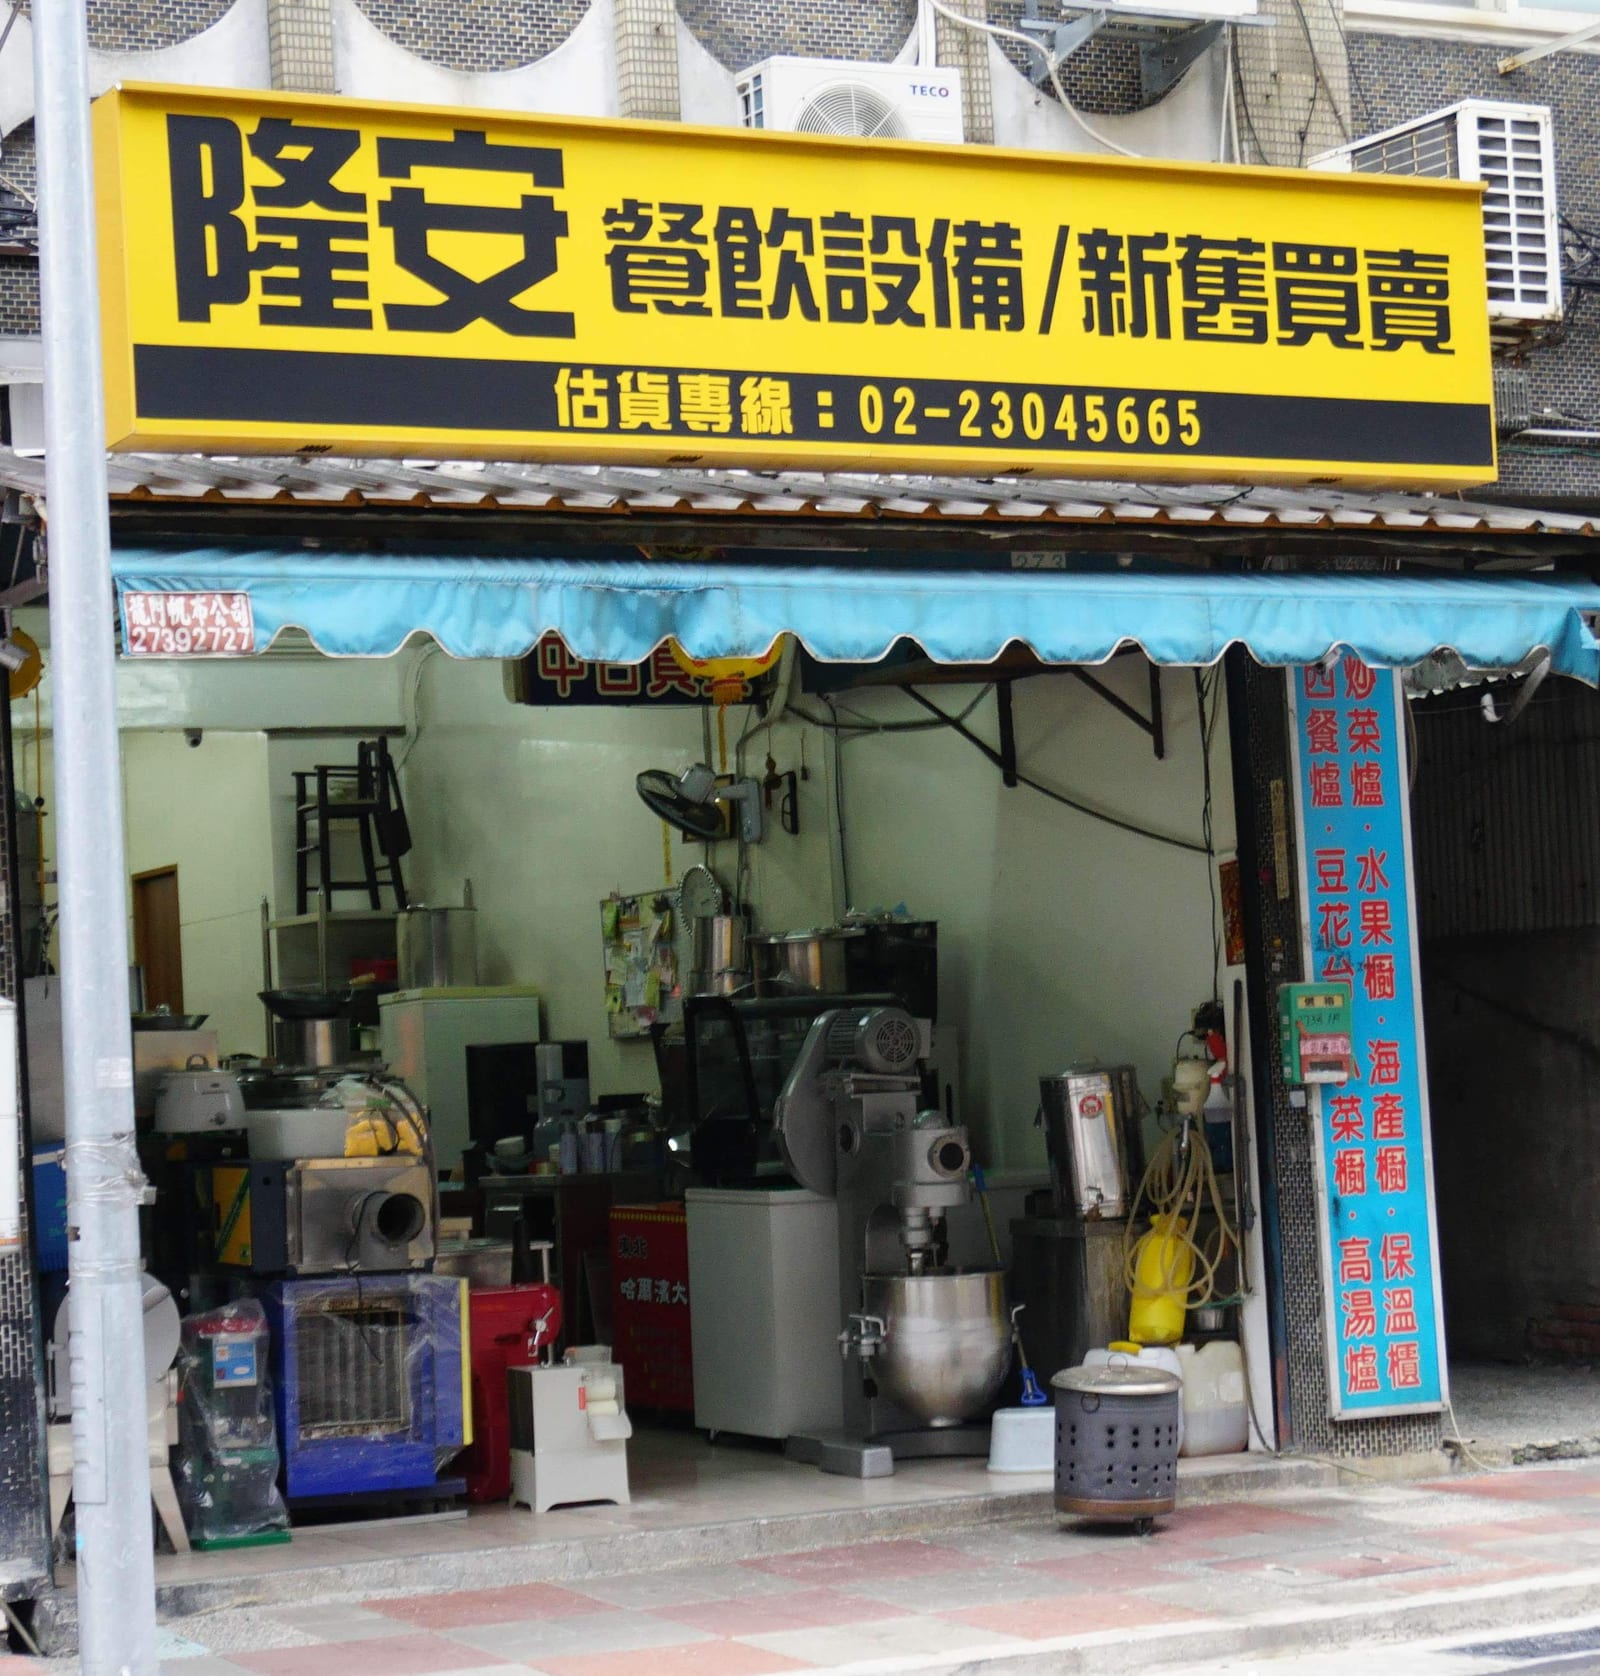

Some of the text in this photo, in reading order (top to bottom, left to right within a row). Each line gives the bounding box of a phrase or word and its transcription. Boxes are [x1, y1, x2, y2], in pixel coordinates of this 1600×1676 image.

[909, 84, 949, 98] TECO
[166, 113, 576, 339] 隆安
[131, 626, 250, 652] 27392727
